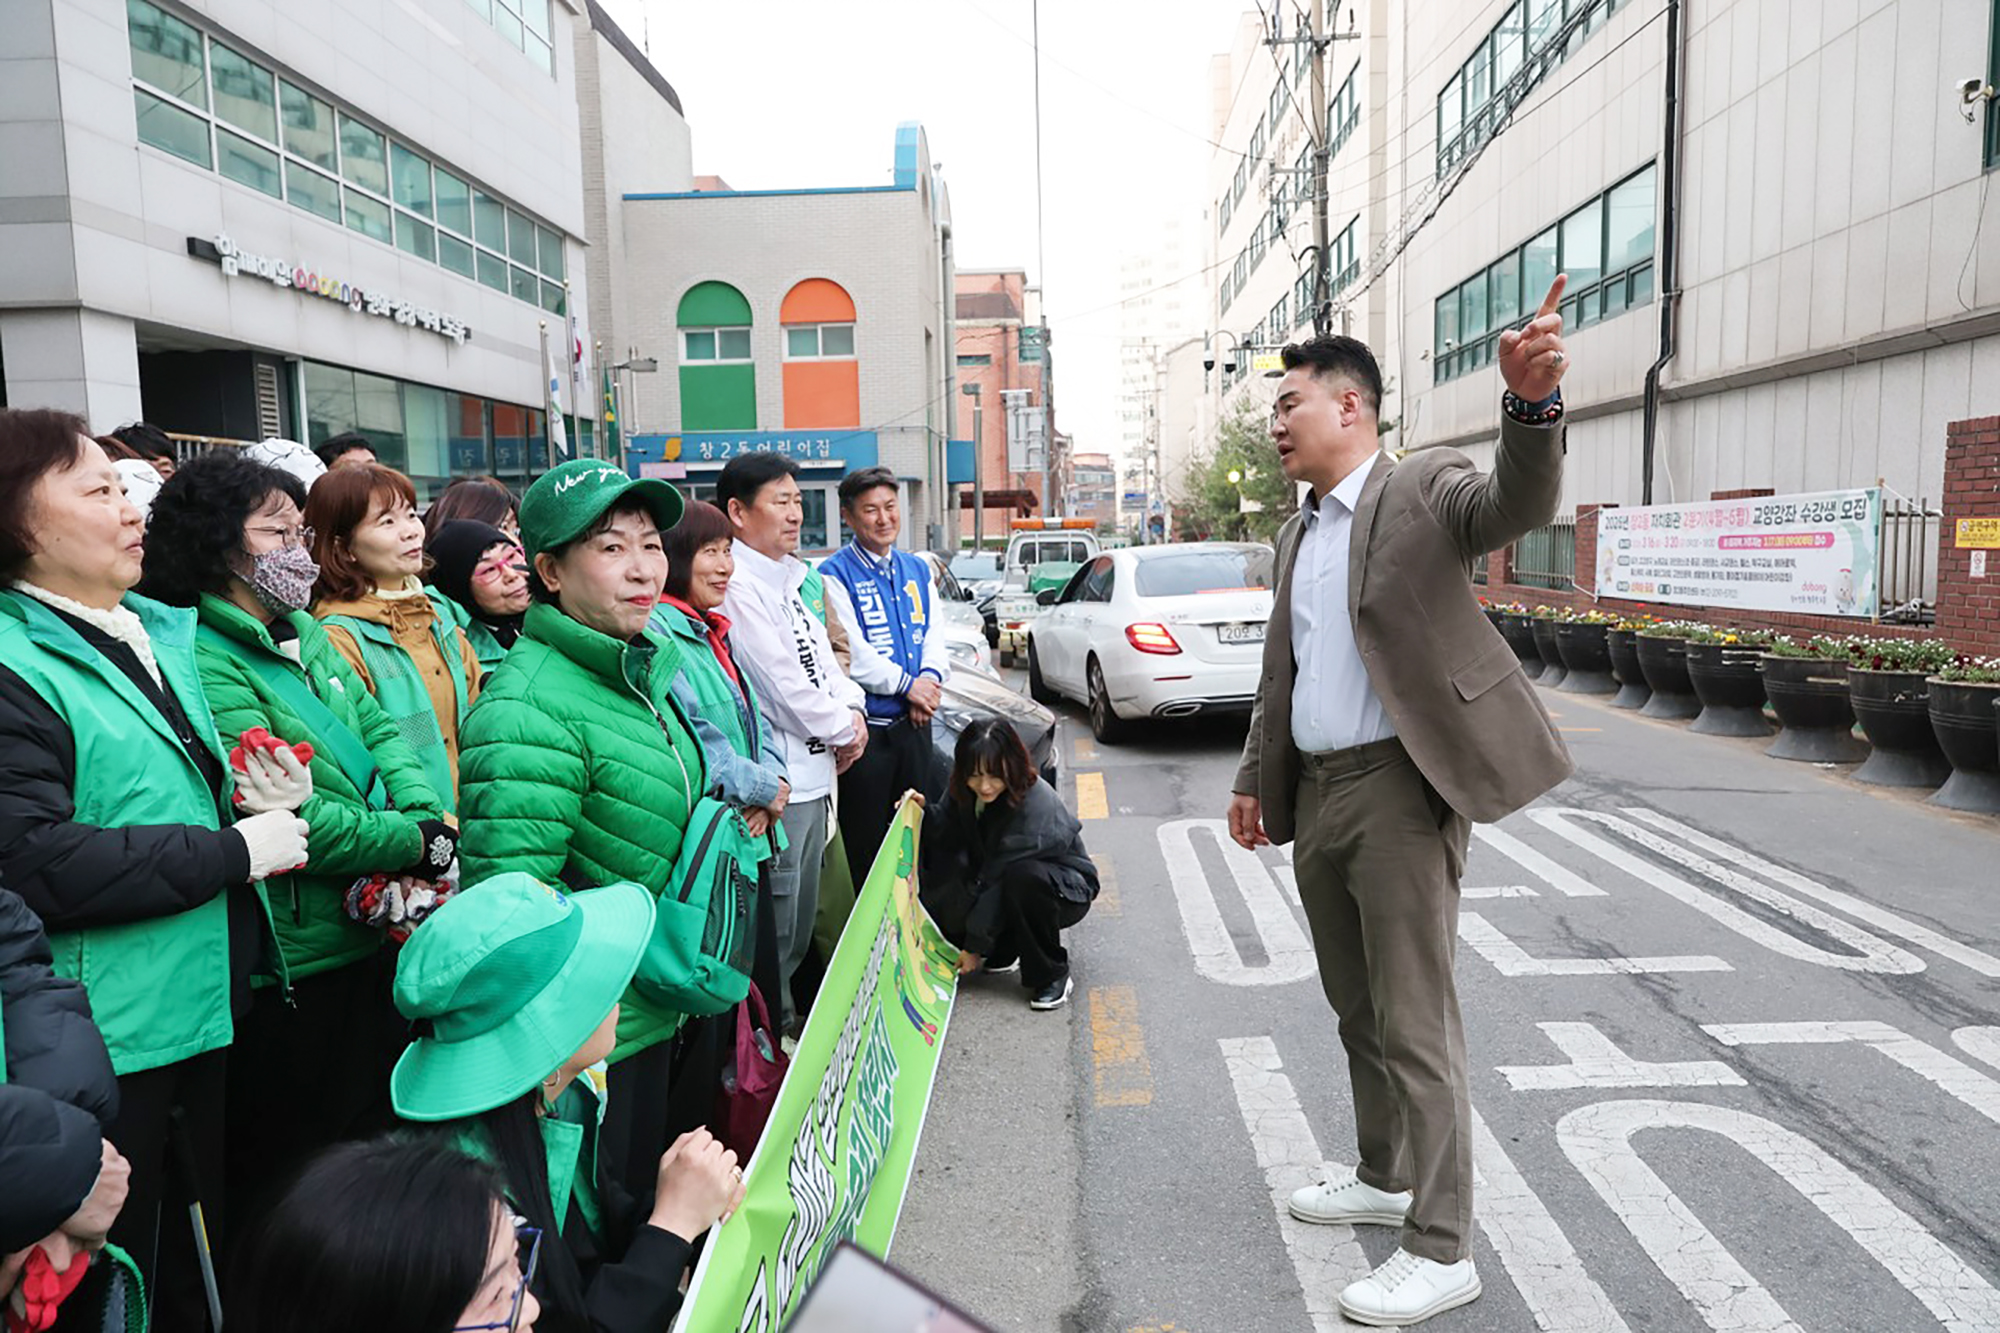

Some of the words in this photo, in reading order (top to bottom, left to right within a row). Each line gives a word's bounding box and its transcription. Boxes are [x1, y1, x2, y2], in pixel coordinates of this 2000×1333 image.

[555, 468, 594, 497] New
[1753, 503, 1797, 526] 교양강좌
[1800, 500, 1837, 524] 수강생
[1840, 497, 1867, 520] 모집
